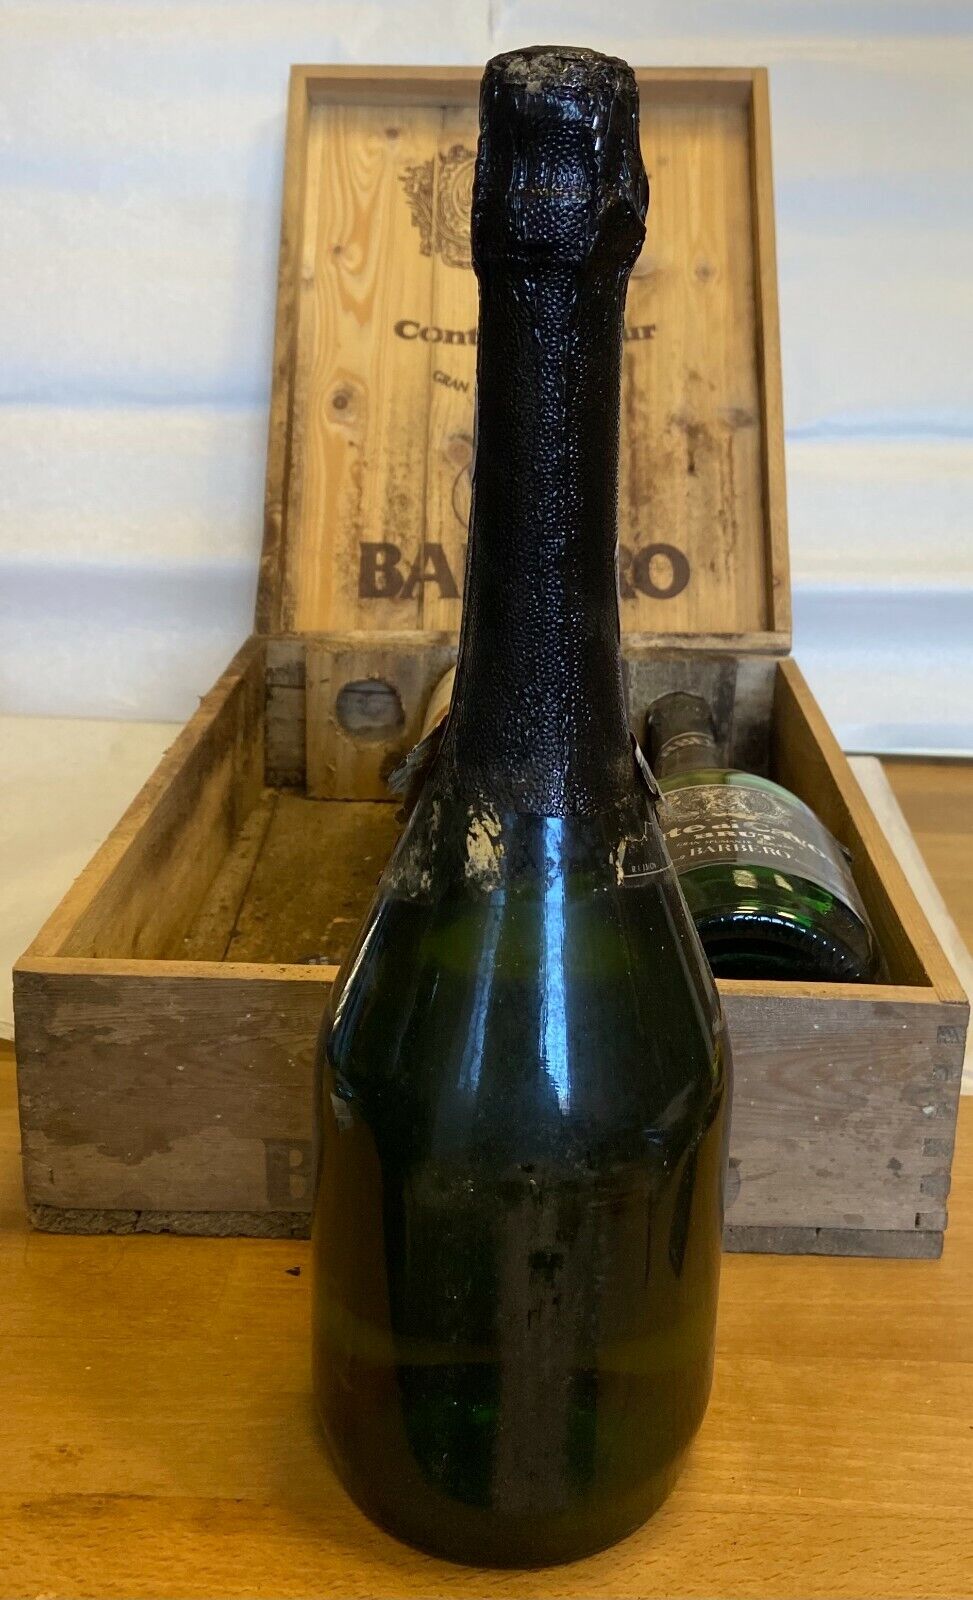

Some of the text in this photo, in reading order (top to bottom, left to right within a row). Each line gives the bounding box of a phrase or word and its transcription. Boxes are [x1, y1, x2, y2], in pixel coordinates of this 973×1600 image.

[394, 319, 477, 346] Cont
[432, 370, 470, 393] GRAN
[690, 844, 791, 859] BARBERO
